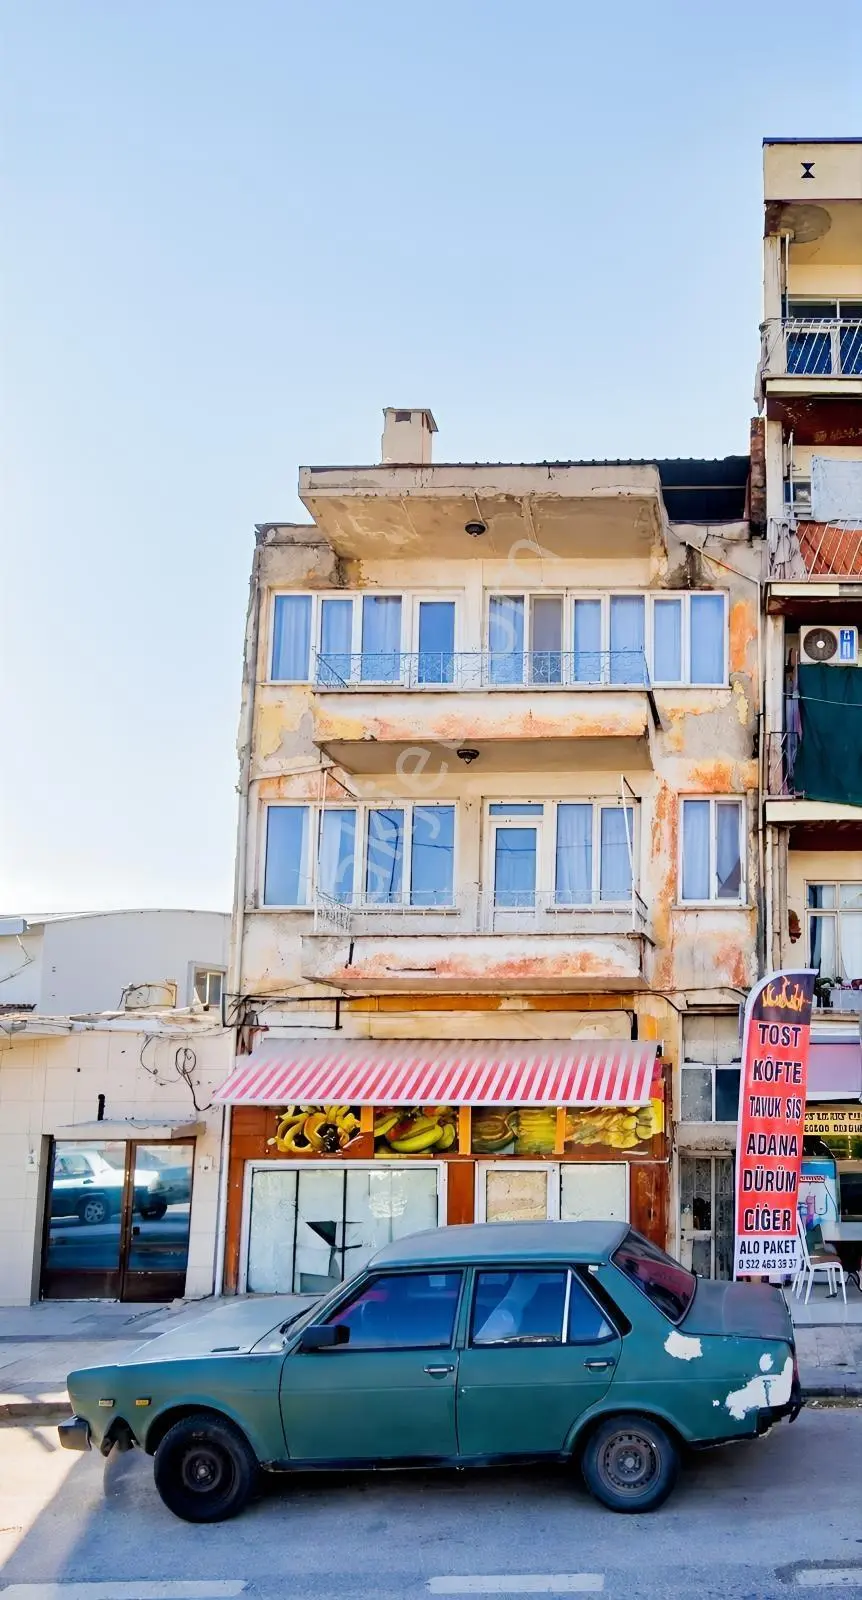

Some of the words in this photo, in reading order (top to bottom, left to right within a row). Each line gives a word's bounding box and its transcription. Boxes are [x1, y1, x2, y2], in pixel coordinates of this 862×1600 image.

[758, 1024, 802, 1047] TOST
[753, 1056, 802, 1083] KÖFTE
[749, 1096, 781, 1117] TAVUK
[747, 1134, 797, 1156] ADANA
[743, 1166, 797, 1192] DÜRÜM
[740, 1240, 760, 1254] ALO
[763, 1240, 796, 1254] PAKET
[739, 1260, 744, 1269] 0
[746, 1260, 760, 1269] 522
